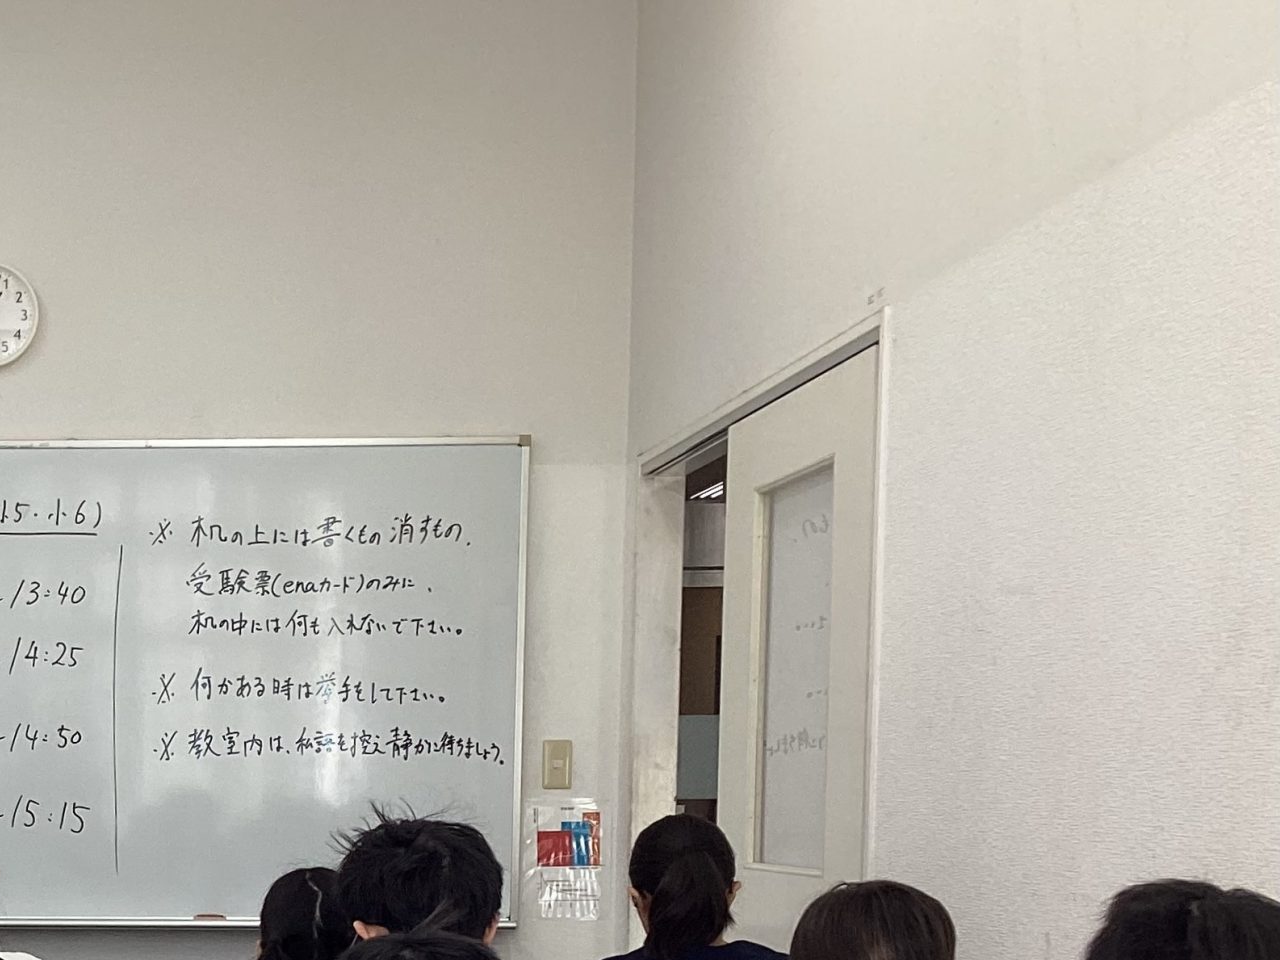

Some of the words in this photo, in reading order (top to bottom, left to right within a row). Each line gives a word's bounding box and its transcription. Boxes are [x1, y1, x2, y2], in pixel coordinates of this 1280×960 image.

[3, 278, 9, 290] 1
[15, 291, 23, 303] 2
[20, 309, 28, 321] 3
[13, 328, 21, 340] 4
[1, 341, 9, 353] 5
